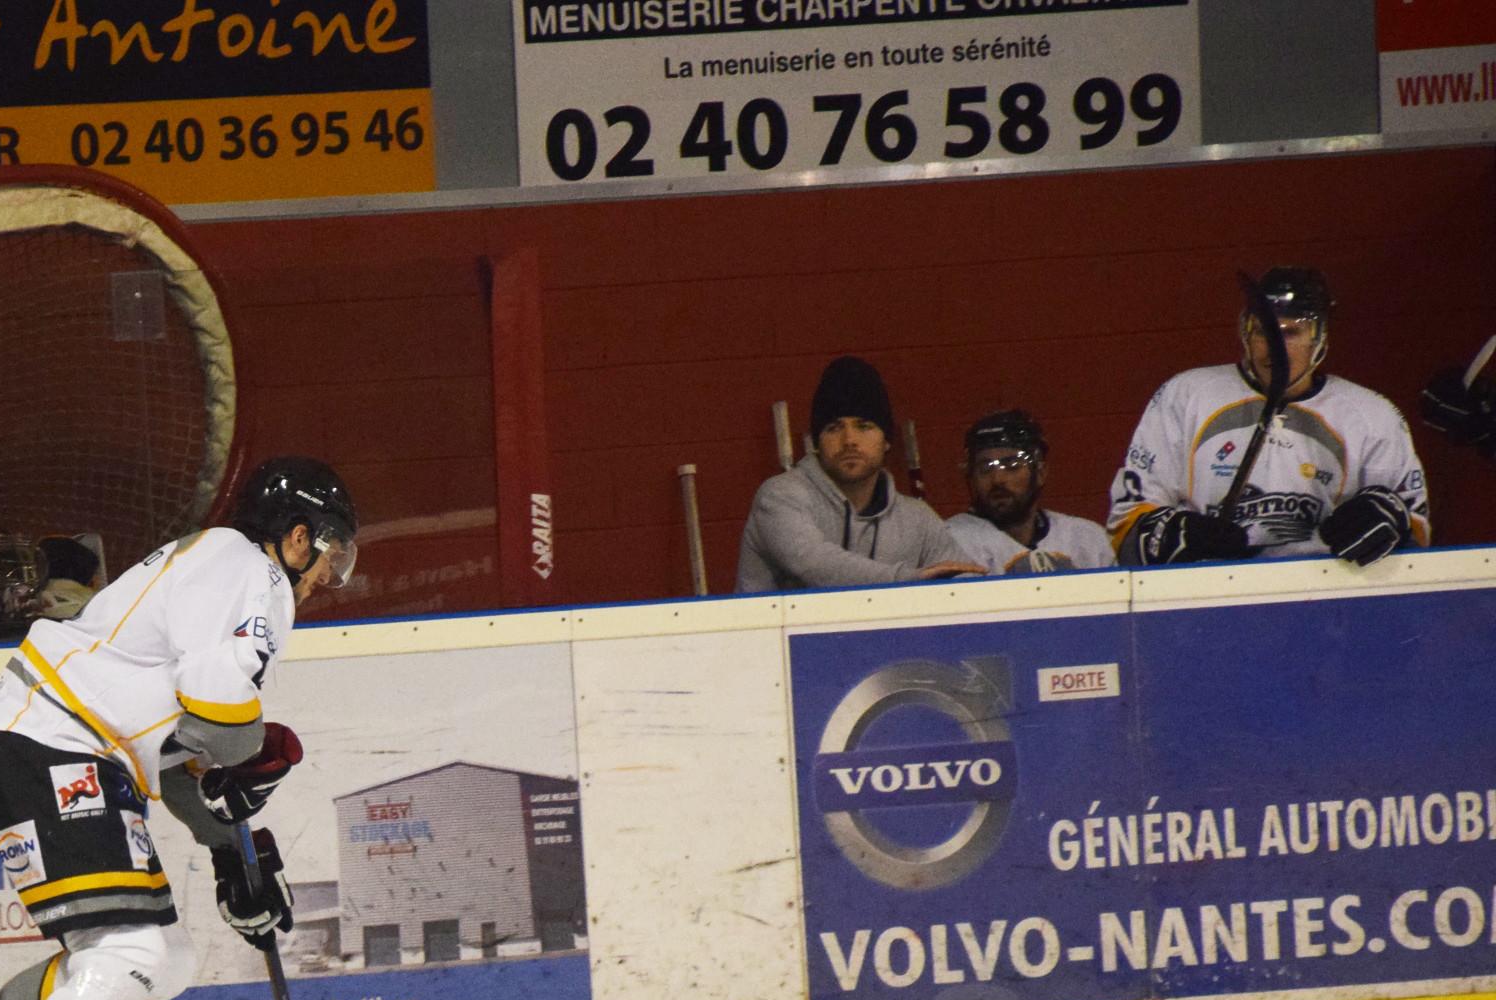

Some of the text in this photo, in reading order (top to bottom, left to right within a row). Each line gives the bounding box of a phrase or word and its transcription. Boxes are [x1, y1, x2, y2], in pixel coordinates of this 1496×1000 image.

[34, 0, 417, 72] Antoine
[529, 0, 746, 36] MENUISERIE
[663, 34, 1052, 80] La menuiserie en toute sérénité
[70, 121, 132, 168] 02
[144, 117, 204, 164] 40
[218, 113, 279, 161] 36
[290, 110, 351, 158] 95
[364, 106, 425, 153] 46
[545, 73, 1183, 182] 02 40 76 58 99
[1050, 671, 1107, 690] PORTE
[829, 757, 1003, 795] VOLVO
[1047, 796, 1248, 872] GÉNÉRAL
[819, 886, 1496, 992] VOLVO-NANTES.CO
